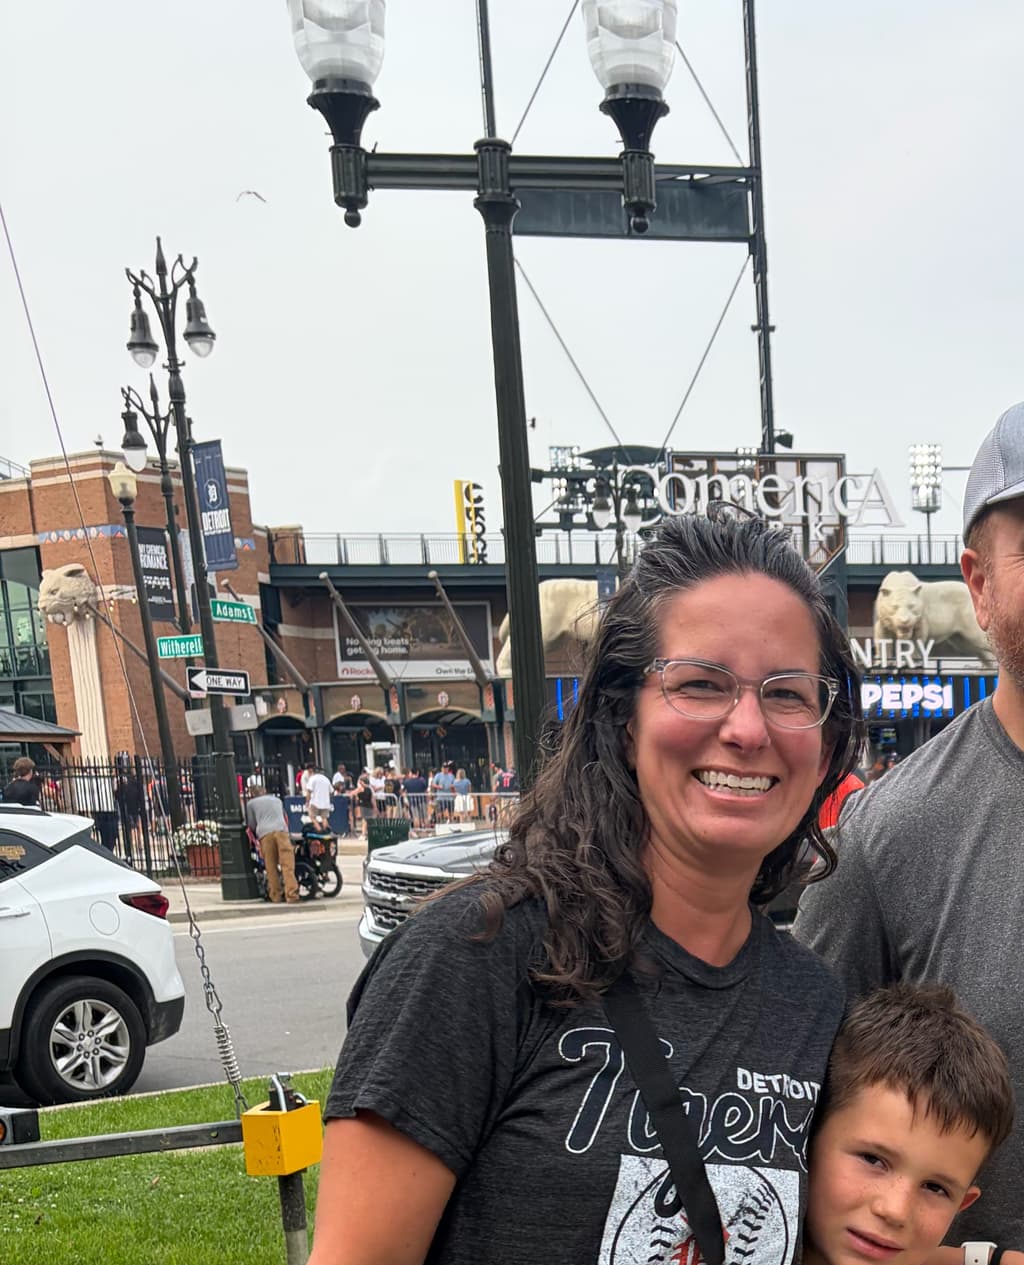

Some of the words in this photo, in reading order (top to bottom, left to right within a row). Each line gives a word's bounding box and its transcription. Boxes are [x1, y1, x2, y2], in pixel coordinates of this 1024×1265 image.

[201, 508, 231, 531] DETROIT
[139, 553, 169, 570] ROMANCE
[216, 603, 246, 617] Adams
[246, 607, 254, 620] E
[160, 638, 203, 656] Witherell
[850, 638, 935, 668] NTRY
[206, 676, 222, 687] ONE
[226, 677, 243, 689] WAY
[861, 683, 953, 709] PEPSI
[737, 1067, 821, 1100] DETROIT
